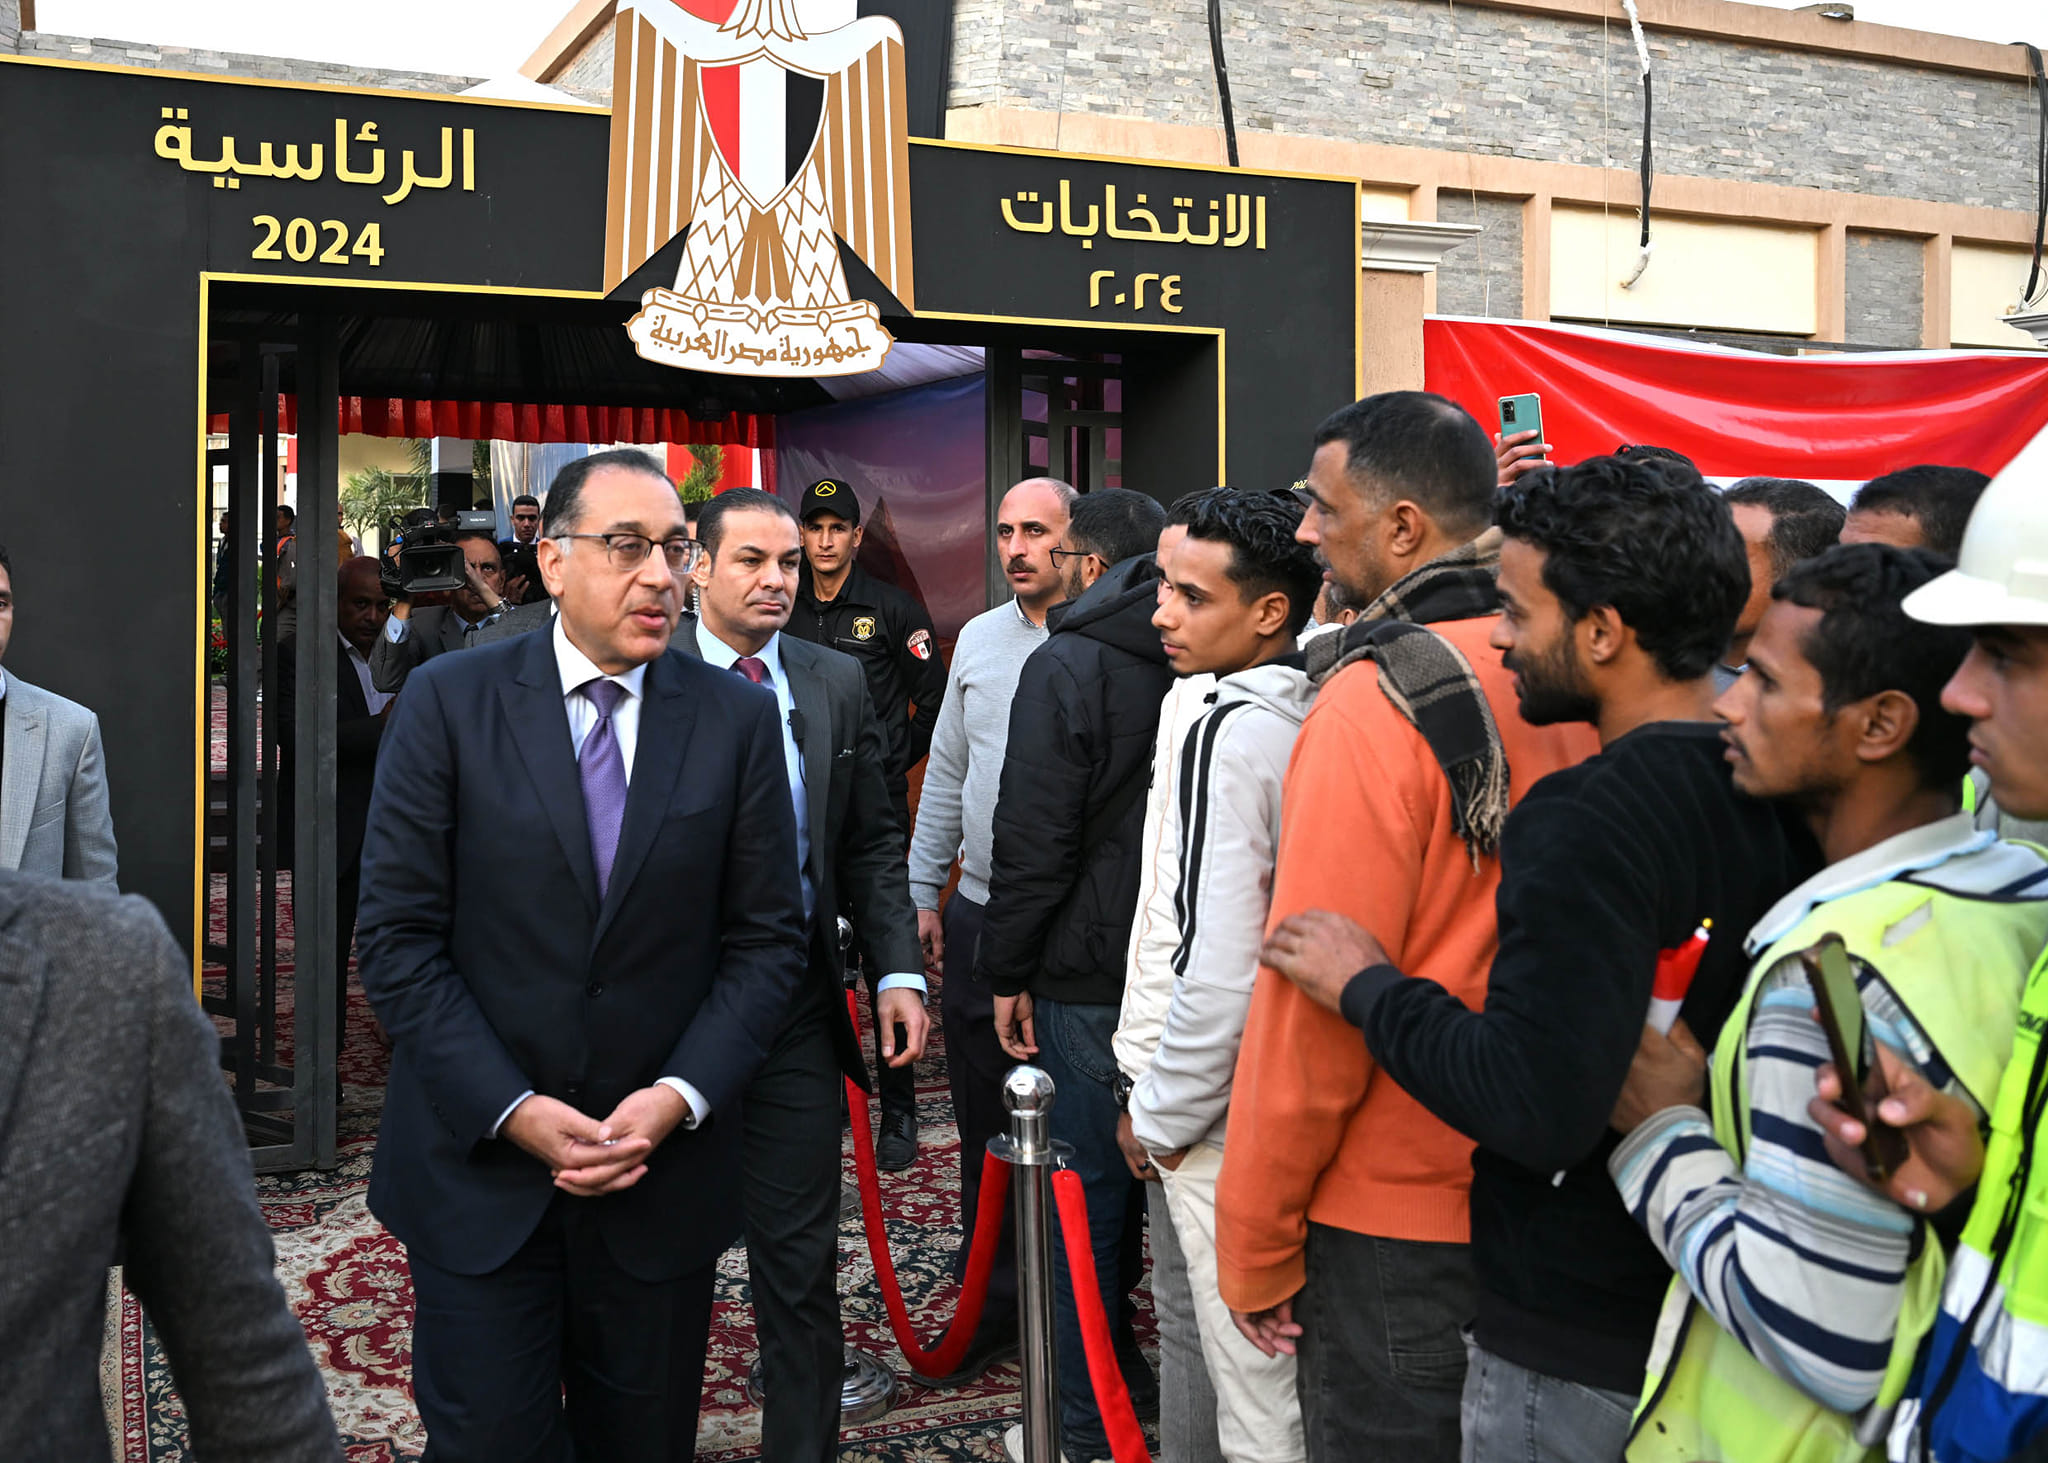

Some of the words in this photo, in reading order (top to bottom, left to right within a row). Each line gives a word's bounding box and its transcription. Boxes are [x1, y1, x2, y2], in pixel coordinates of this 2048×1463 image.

[154, 106, 475, 205] الرئاسية
[1000, 179, 1266, 250] الانتخابات
[251, 214, 385, 266] 2024
[1089, 269, 1183, 313] ٢٠٢٤
[650, 314, 728, 361] العربية
[723, 342, 778, 367] مصر
[780, 327, 872, 367] جمهورية
